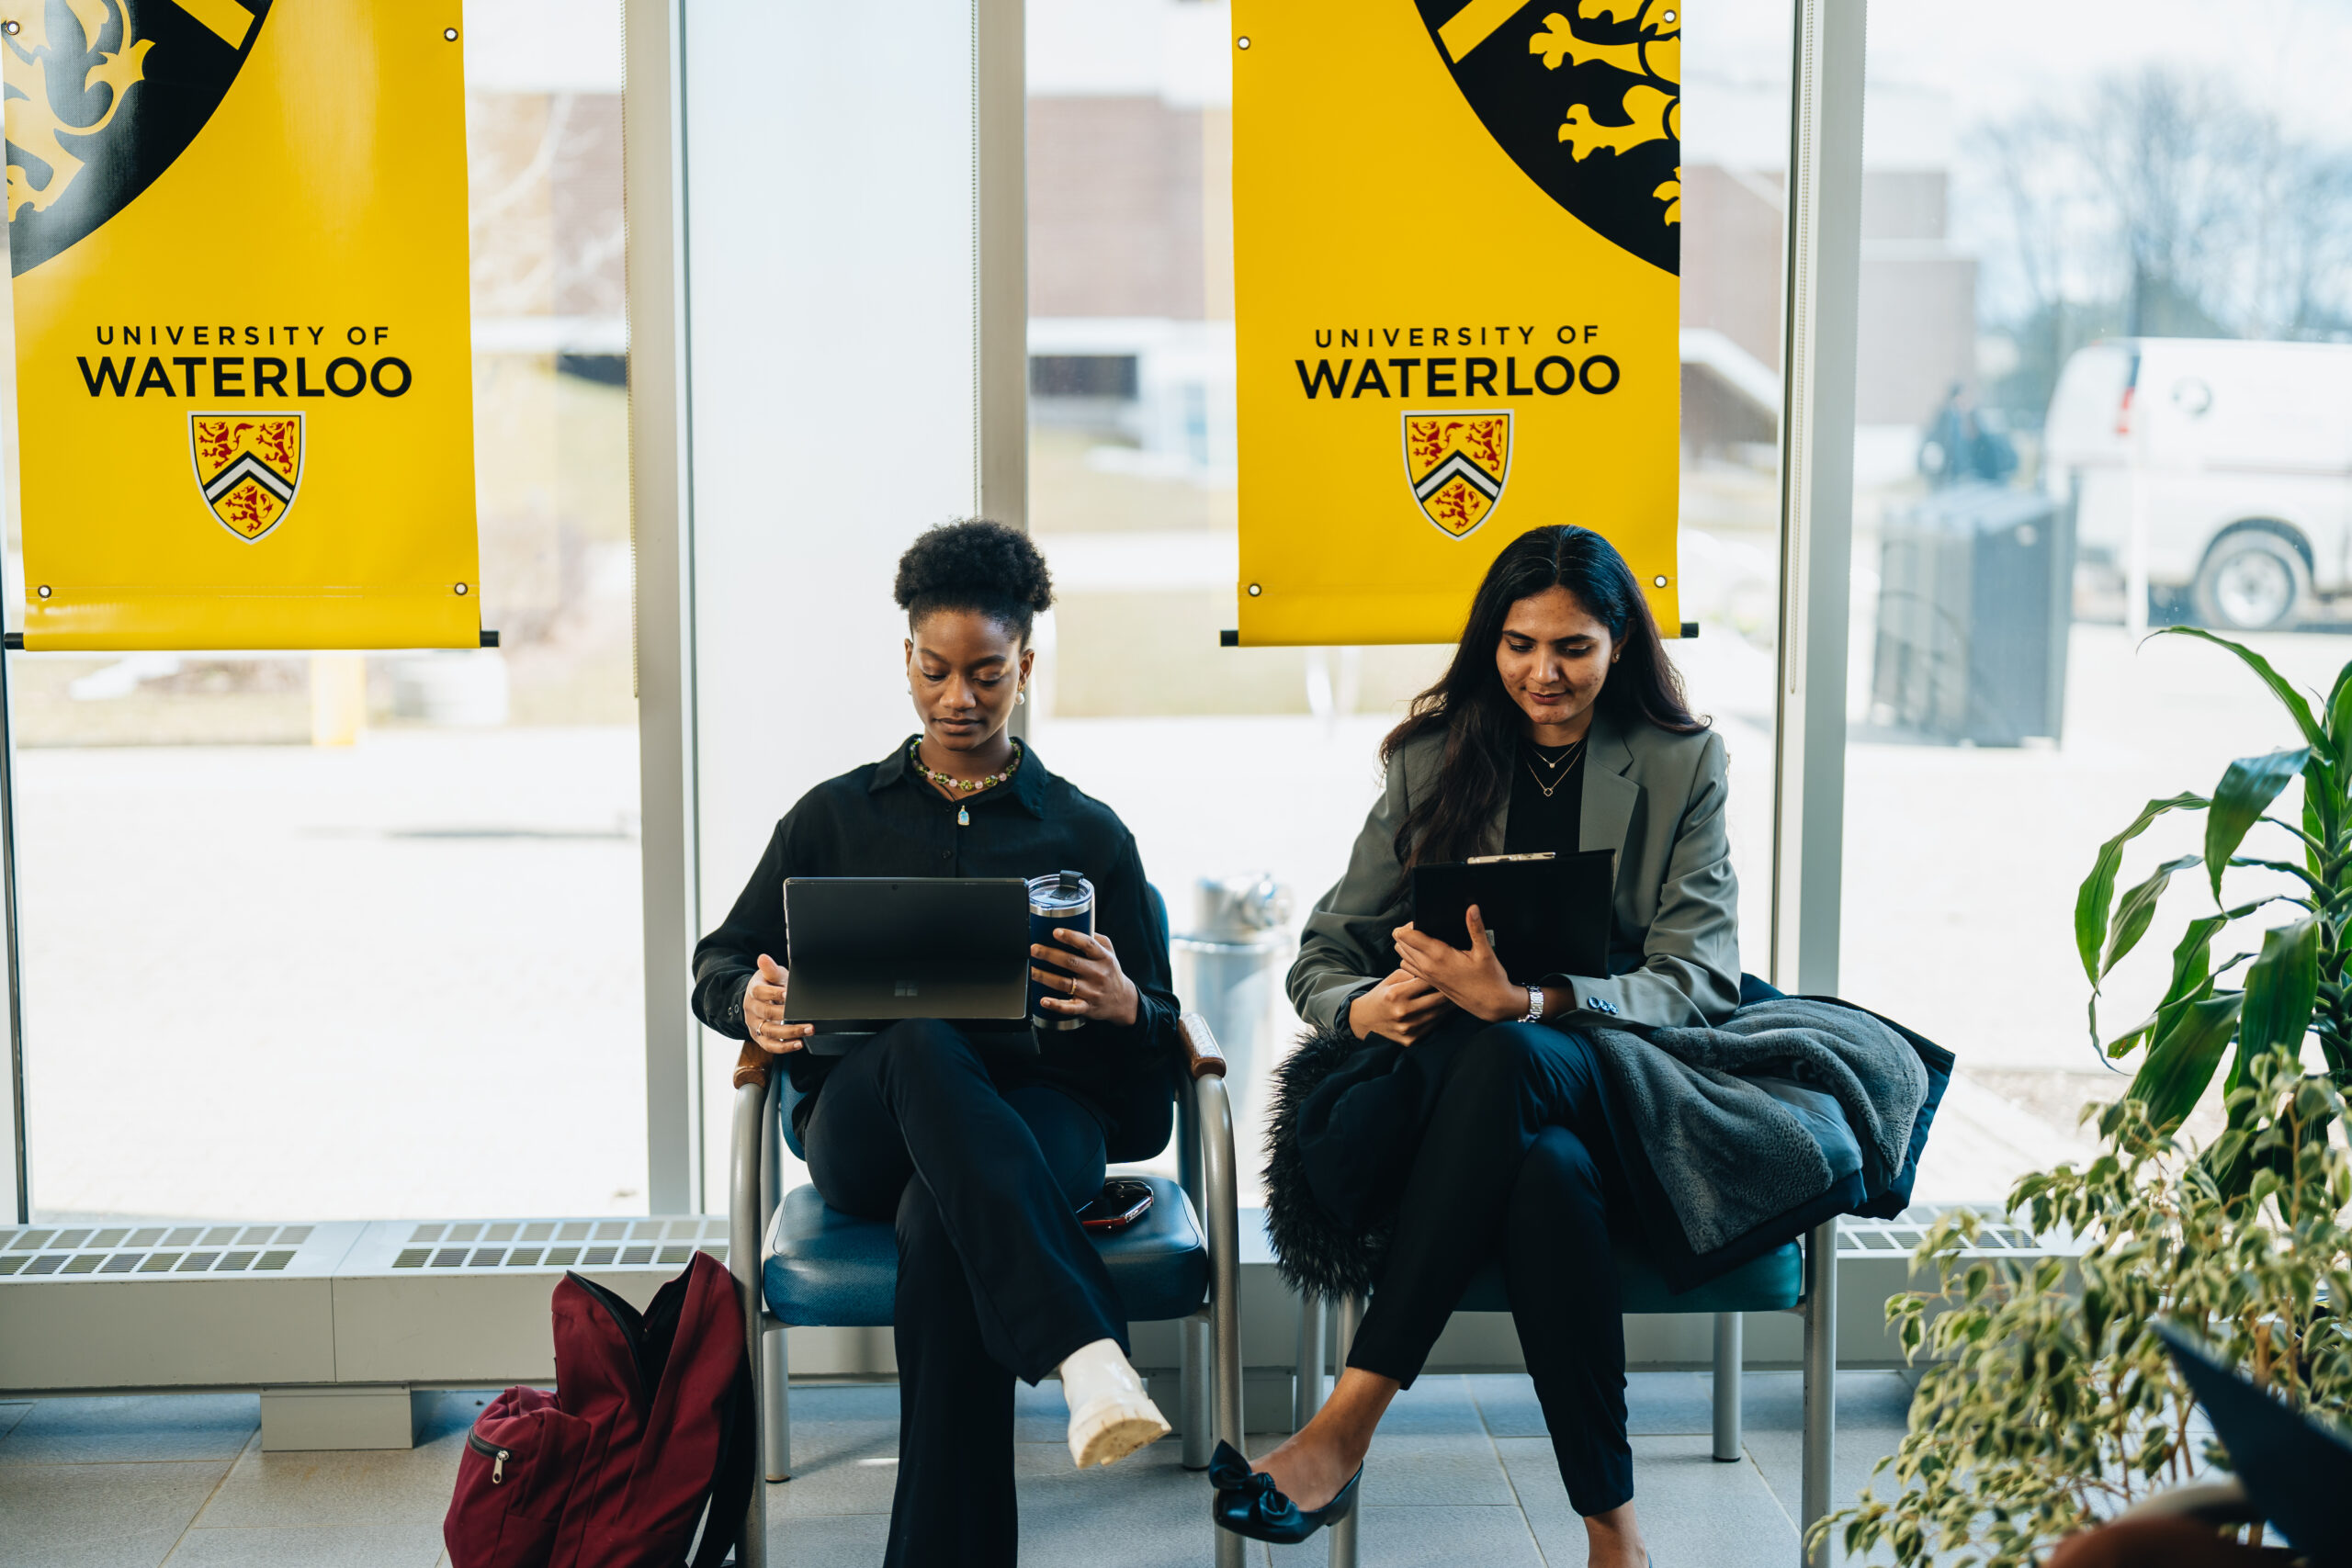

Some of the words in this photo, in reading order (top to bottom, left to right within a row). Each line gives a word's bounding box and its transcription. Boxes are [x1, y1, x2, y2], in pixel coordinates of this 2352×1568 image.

[96, 325, 325, 345] UNIVERSITY
[346, 326, 390, 345] OF
[1316, 326, 1535, 348] UNIVERSITY
[1556, 325, 1600, 344] OF
[76, 355, 413, 398] WATERLOO
[1295, 355, 1621, 400] WATERLOO
